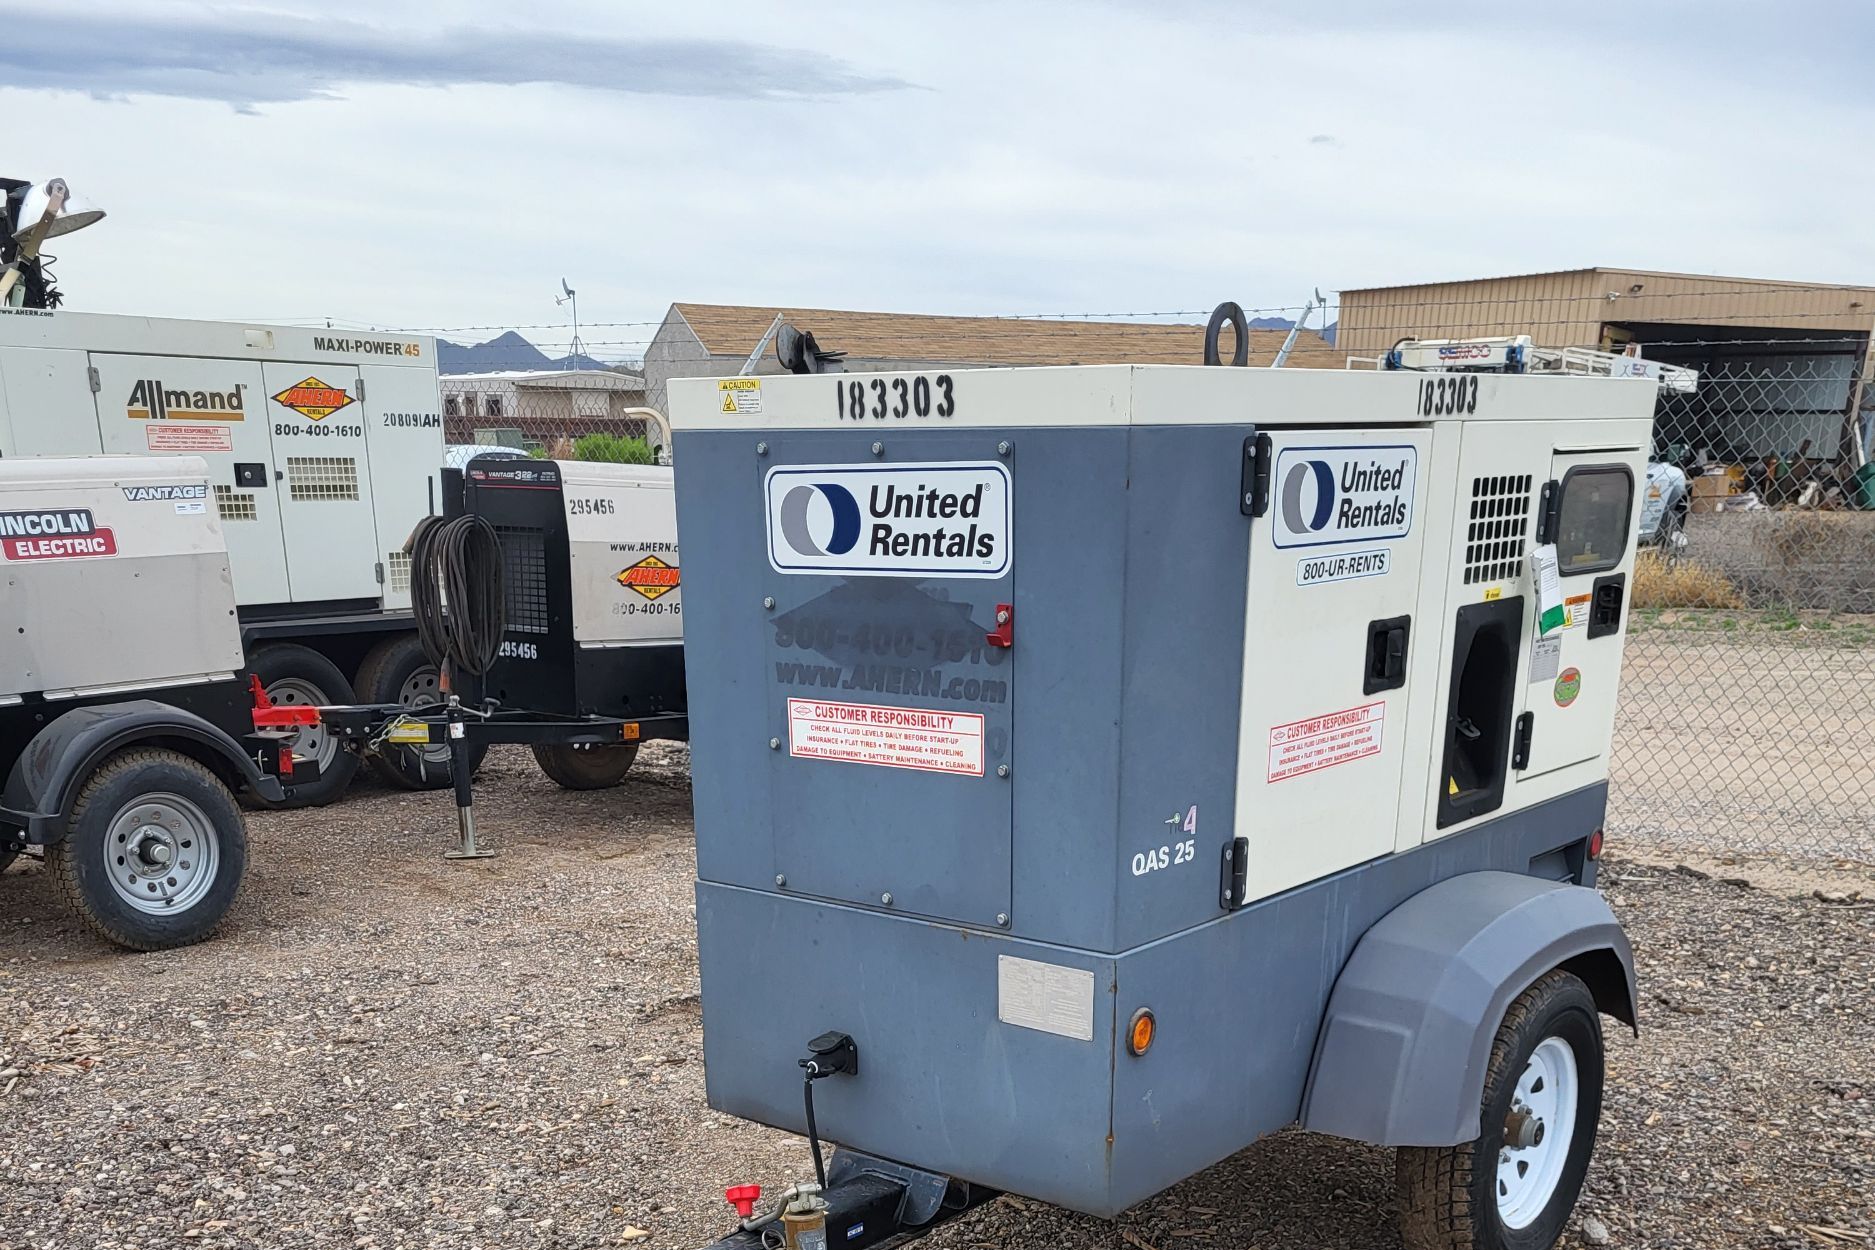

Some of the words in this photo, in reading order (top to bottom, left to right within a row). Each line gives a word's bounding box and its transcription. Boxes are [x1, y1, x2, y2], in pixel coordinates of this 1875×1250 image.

[0, 309, 54, 317] ww.AHERN.com
[314, 337, 403, 355] MAXI-POWER
[405, 344, 420, 356] 45
[728, 380, 756, 389] CAUTION
[127, 379, 244, 420] Allmand
[283, 387, 345, 407] AHERN
[837, 374, 955, 421] 183303
[1418, 375, 1479, 417] 183303
[274, 423, 362, 437] 800-400-1610
[1340, 459, 1406, 494] United
[123, 486, 207, 501] VANTAGE
[869, 483, 984, 519] United
[570, 498, 615, 515] 295456
[1336, 497, 1407, 530] Rentals
[0, 512, 90, 536] INCOLN
[15, 537, 106, 557] ELECTRIC
[610, 542, 679, 553] www.AHERN.c
[869, 523, 995, 559] Rentals
[622, 567, 680, 586] AHERN
[1302, 553, 1385, 582] 800-UR-RENTS
[612, 602, 681, 615] 800-400-16
[498, 641, 538, 660] 295456
[814, 705, 868, 723] CUSTOMER
[870, 710, 954, 730] RESPONSIBILITY
[1287, 721, 1321, 740] CUSTOMER
[1322, 708, 1371, 730] RESPONSIBILITY
[810, 724, 830, 732] CHECK
[831, 725, 842, 734] ALL
[843, 727, 861, 736] FLUID
[862, 729, 884, 738] LEVELS
[885, 731, 902, 740] DAILY
[904, 733, 928, 742] BEFORE
[929, 735, 959, 745] START-UP
[806, 736, 838, 745] INSURANCE
[845, 739, 858, 747] FLAT
[860, 740, 877, 748] TIRES
[883, 743, 896, 751] TIRE
[898, 744, 923, 753] DAMAGE
[929, 747, 964, 757] REFUELING
[796, 745, 819, 754] DAMAGE
[820, 747, 828, 755] TO
[829, 748, 862, 759] EQUIPMENT
[895, 755, 939, 766] MAINTENANCE
[945, 760, 976, 771] CLEANING
[1183, 805, 1197, 835] 4
[1132, 845, 1170, 876] QAS
[1174, 839, 1195, 865] 25
